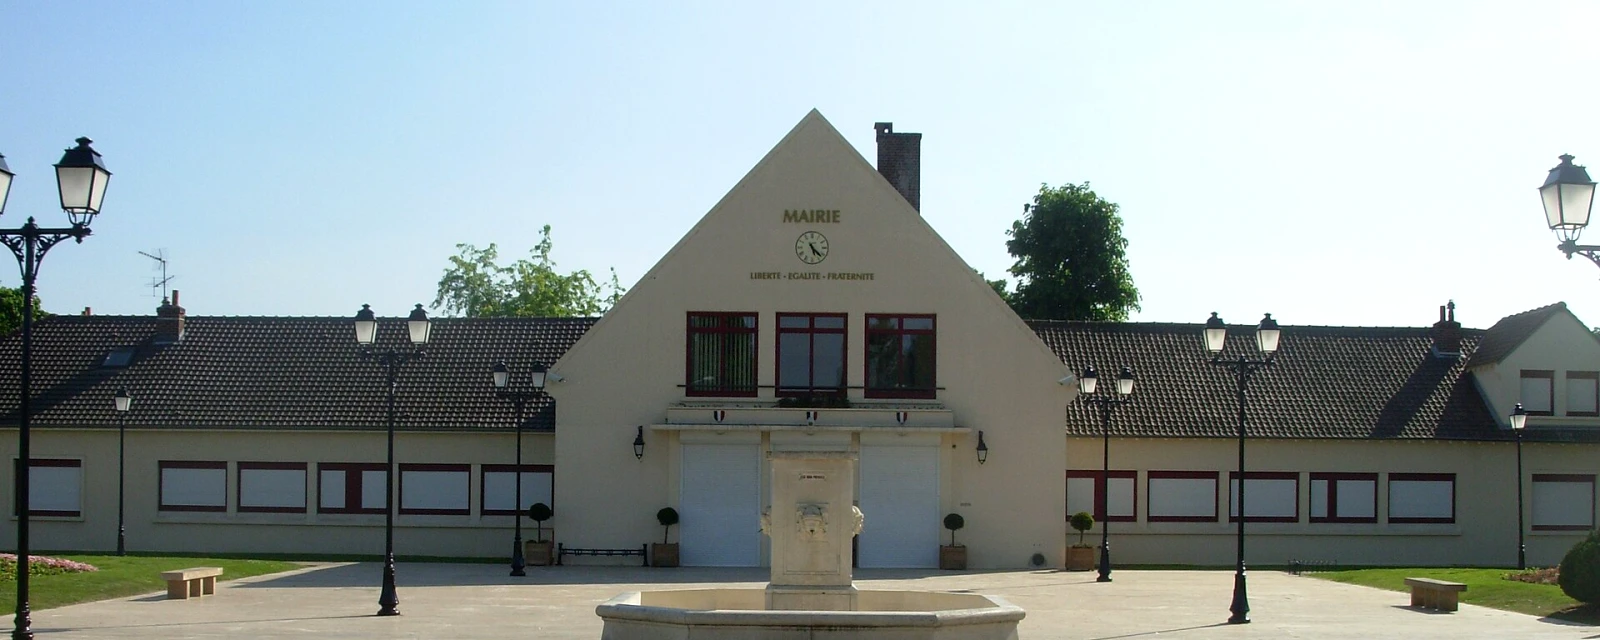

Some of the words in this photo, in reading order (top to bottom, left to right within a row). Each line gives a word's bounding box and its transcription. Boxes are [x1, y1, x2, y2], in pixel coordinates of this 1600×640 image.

[783, 209, 841, 223] MAIRIE
[750, 272, 781, 280] LIBERTE
[788, 272, 820, 280] EGALITE
[827, 272, 875, 281] FRATERNITE
